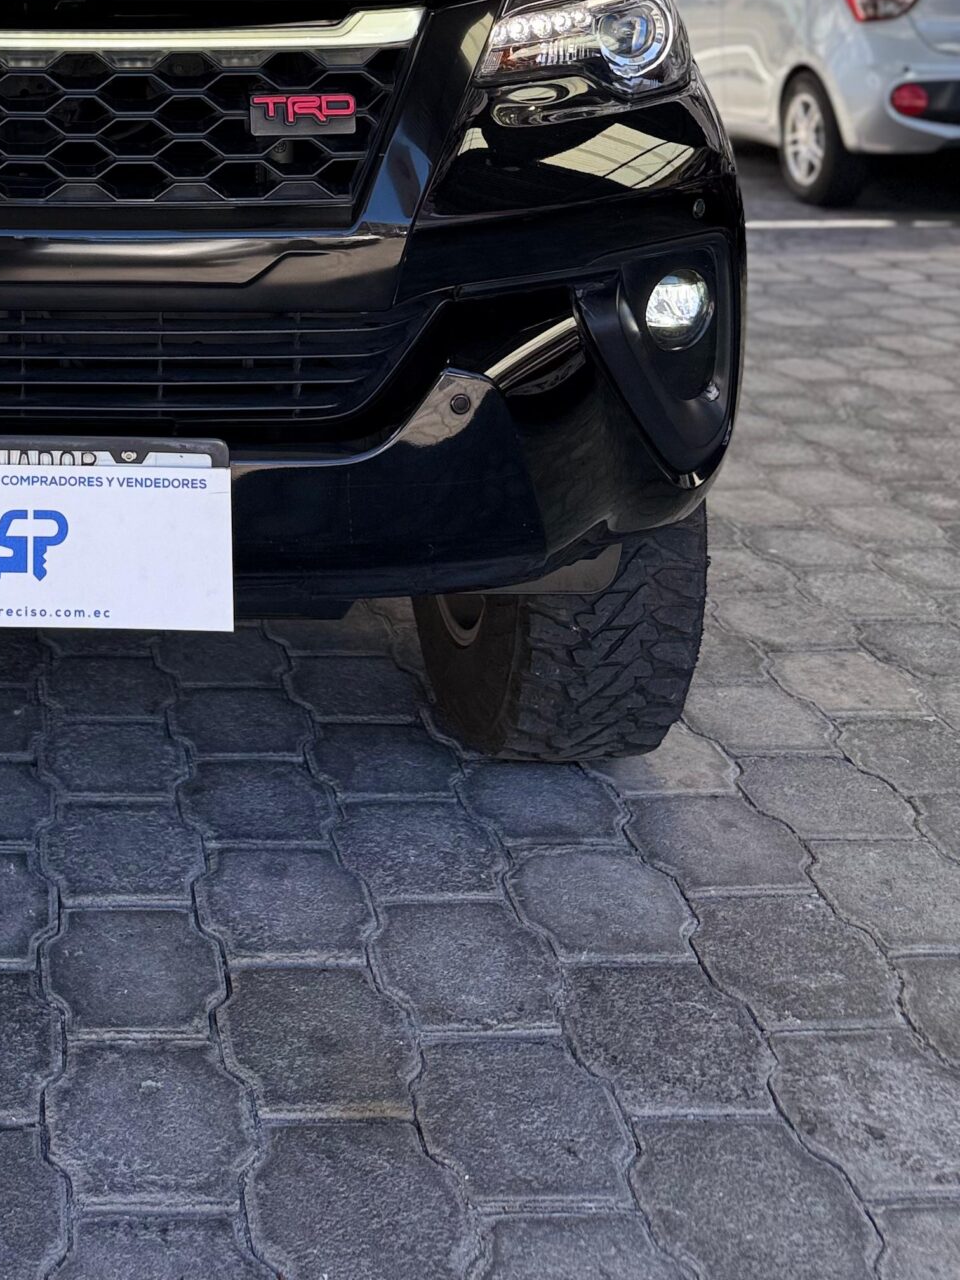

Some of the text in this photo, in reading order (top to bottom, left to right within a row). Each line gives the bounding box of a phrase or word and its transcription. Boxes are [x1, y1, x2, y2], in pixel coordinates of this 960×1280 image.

[253, 94, 356, 123] TRD
[0, 475, 104, 488] COMPRADORES
[106, 477, 115, 488] Y
[114, 477, 208, 490] VENDEDORES
